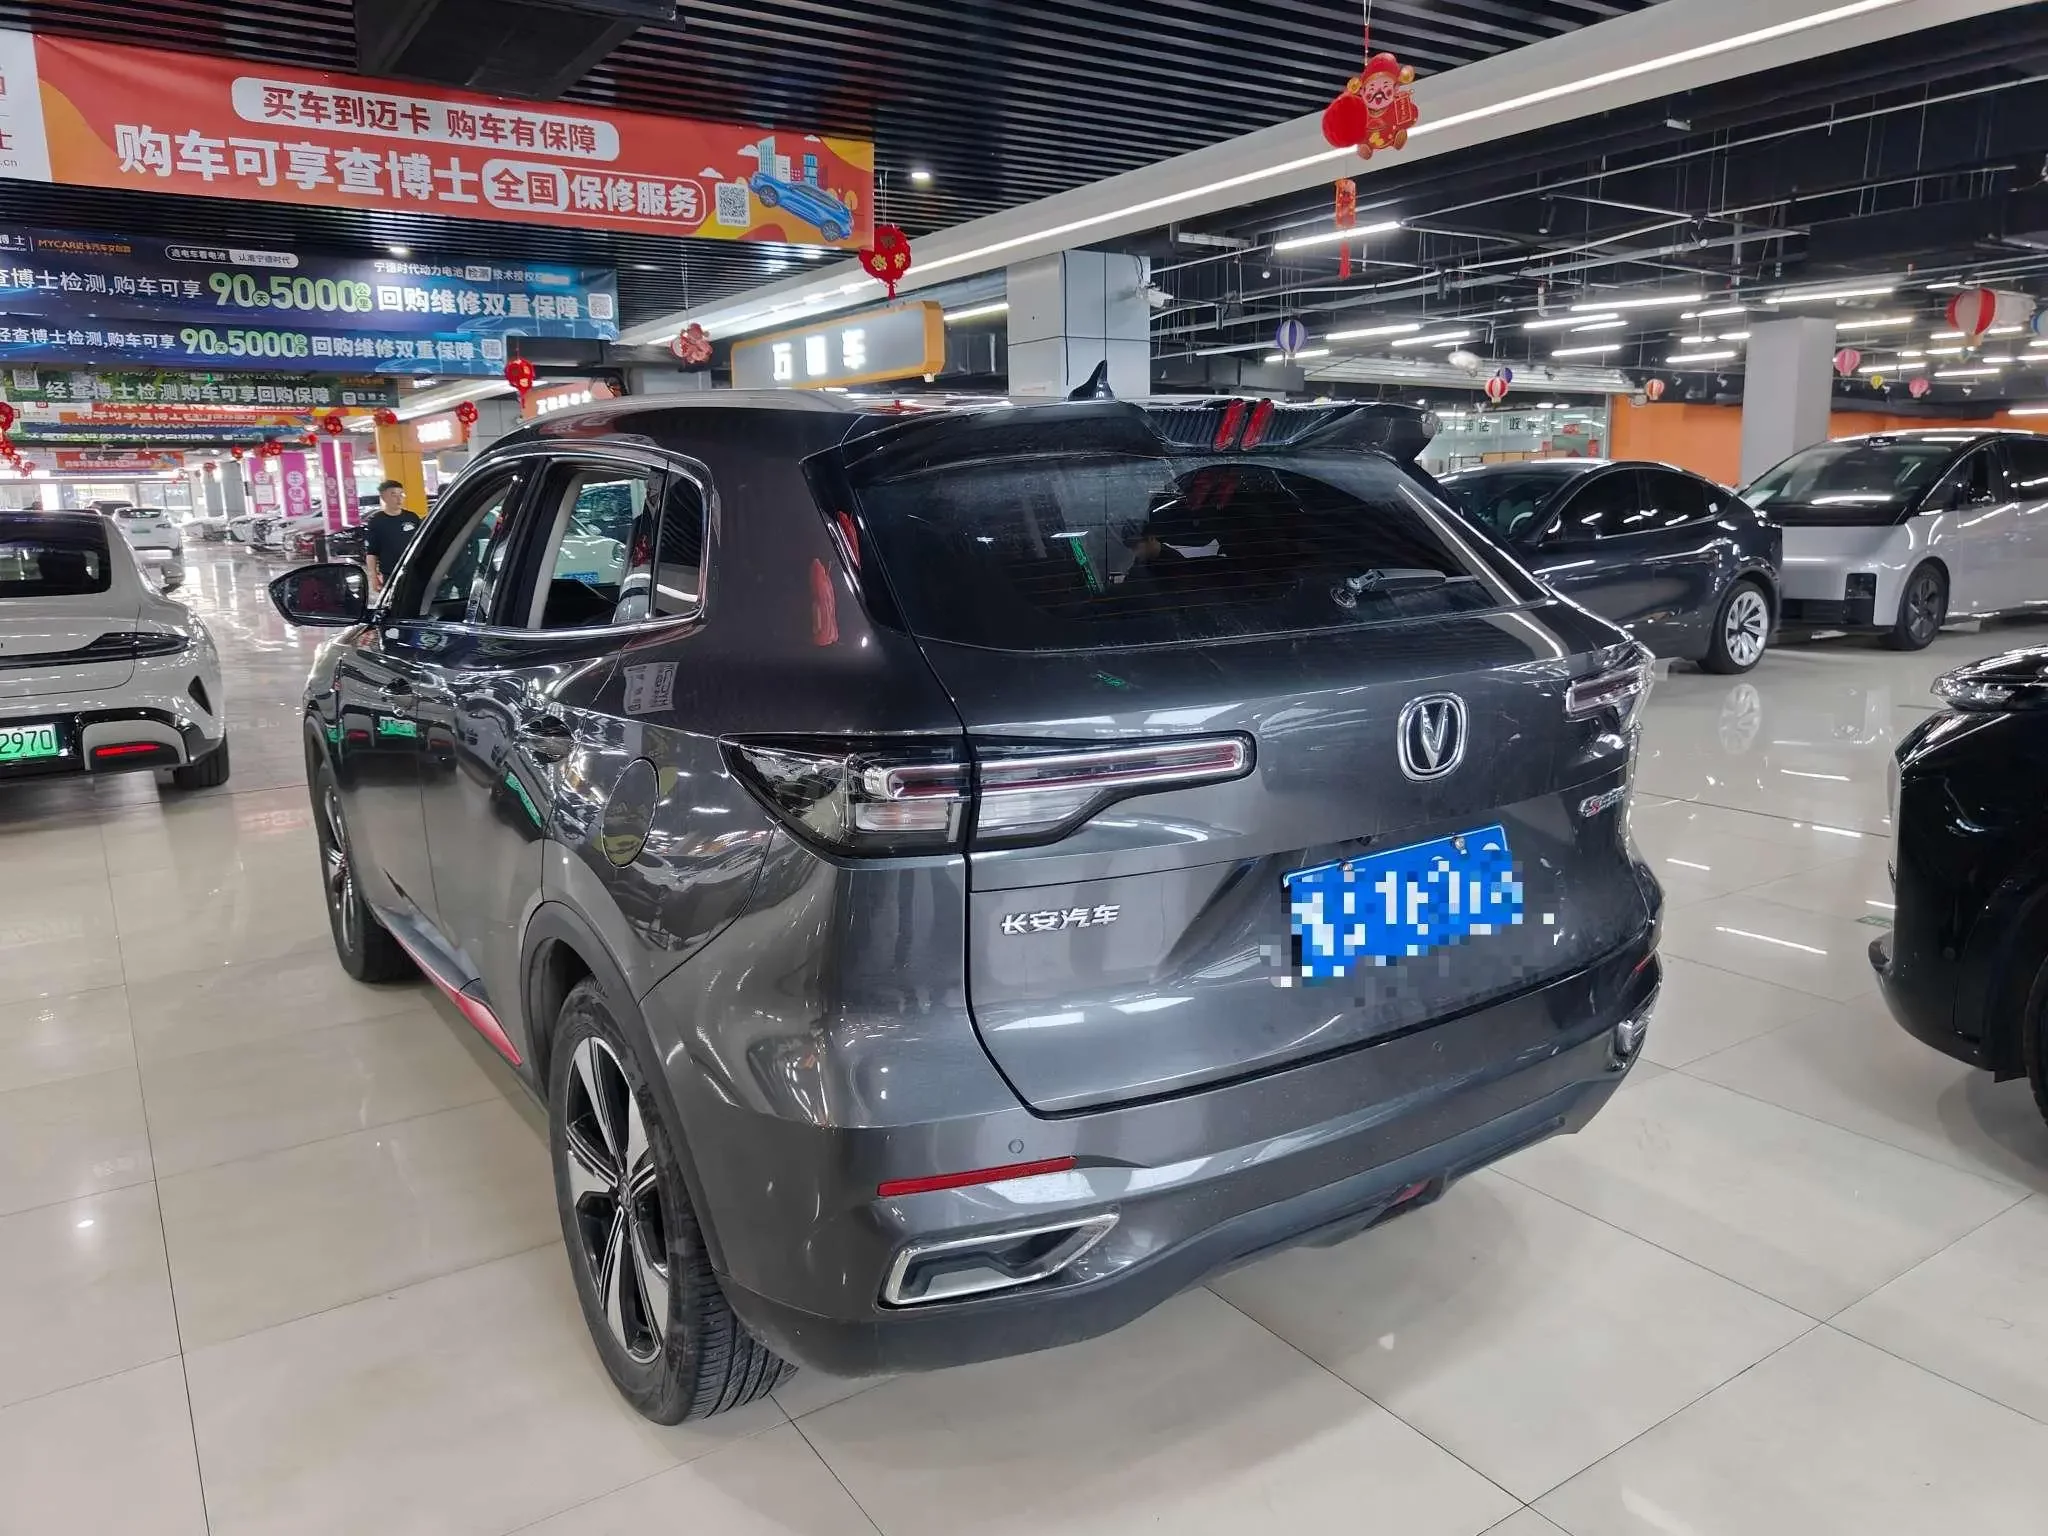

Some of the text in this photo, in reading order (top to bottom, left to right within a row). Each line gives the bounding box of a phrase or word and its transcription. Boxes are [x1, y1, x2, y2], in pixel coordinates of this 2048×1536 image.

[262, 85, 597, 155] 买车到迈卡 购车有保障
[376, 284, 581, 320] 回购维修双重保障
[311, 336, 475, 360] 回购维修双重保障
[46, 380, 331, 405] 经查博士检测购车可享回购保障
[1001, 904, 1121, 936] 长安汽车
